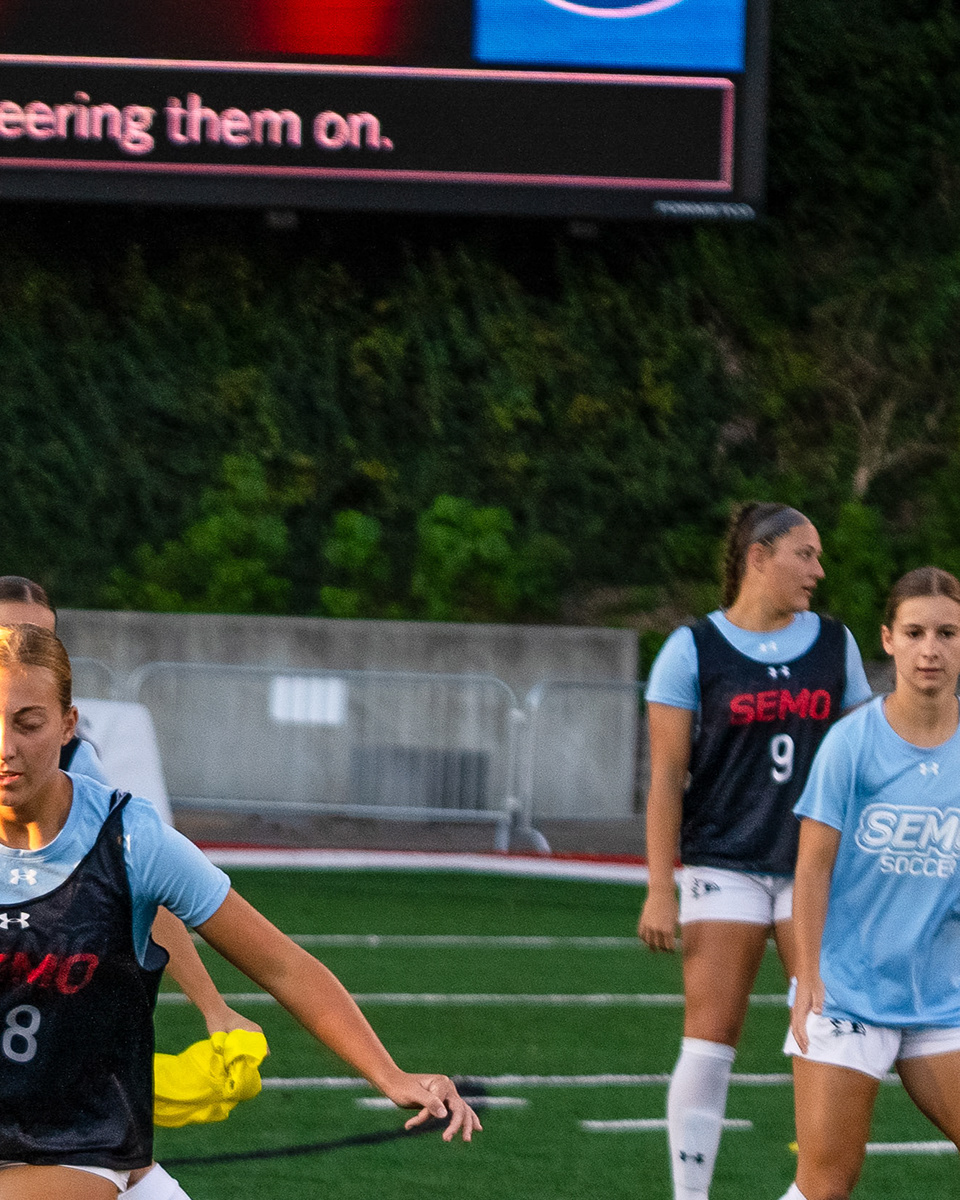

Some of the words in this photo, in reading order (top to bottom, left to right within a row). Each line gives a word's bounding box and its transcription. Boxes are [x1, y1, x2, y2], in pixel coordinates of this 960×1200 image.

[165, 93, 301, 148] them
[313, 110, 393, 151] on.
[729, 688, 831, 725] SEMO
[770, 734, 794, 783] 9
[862, 810, 960, 852] SEM
